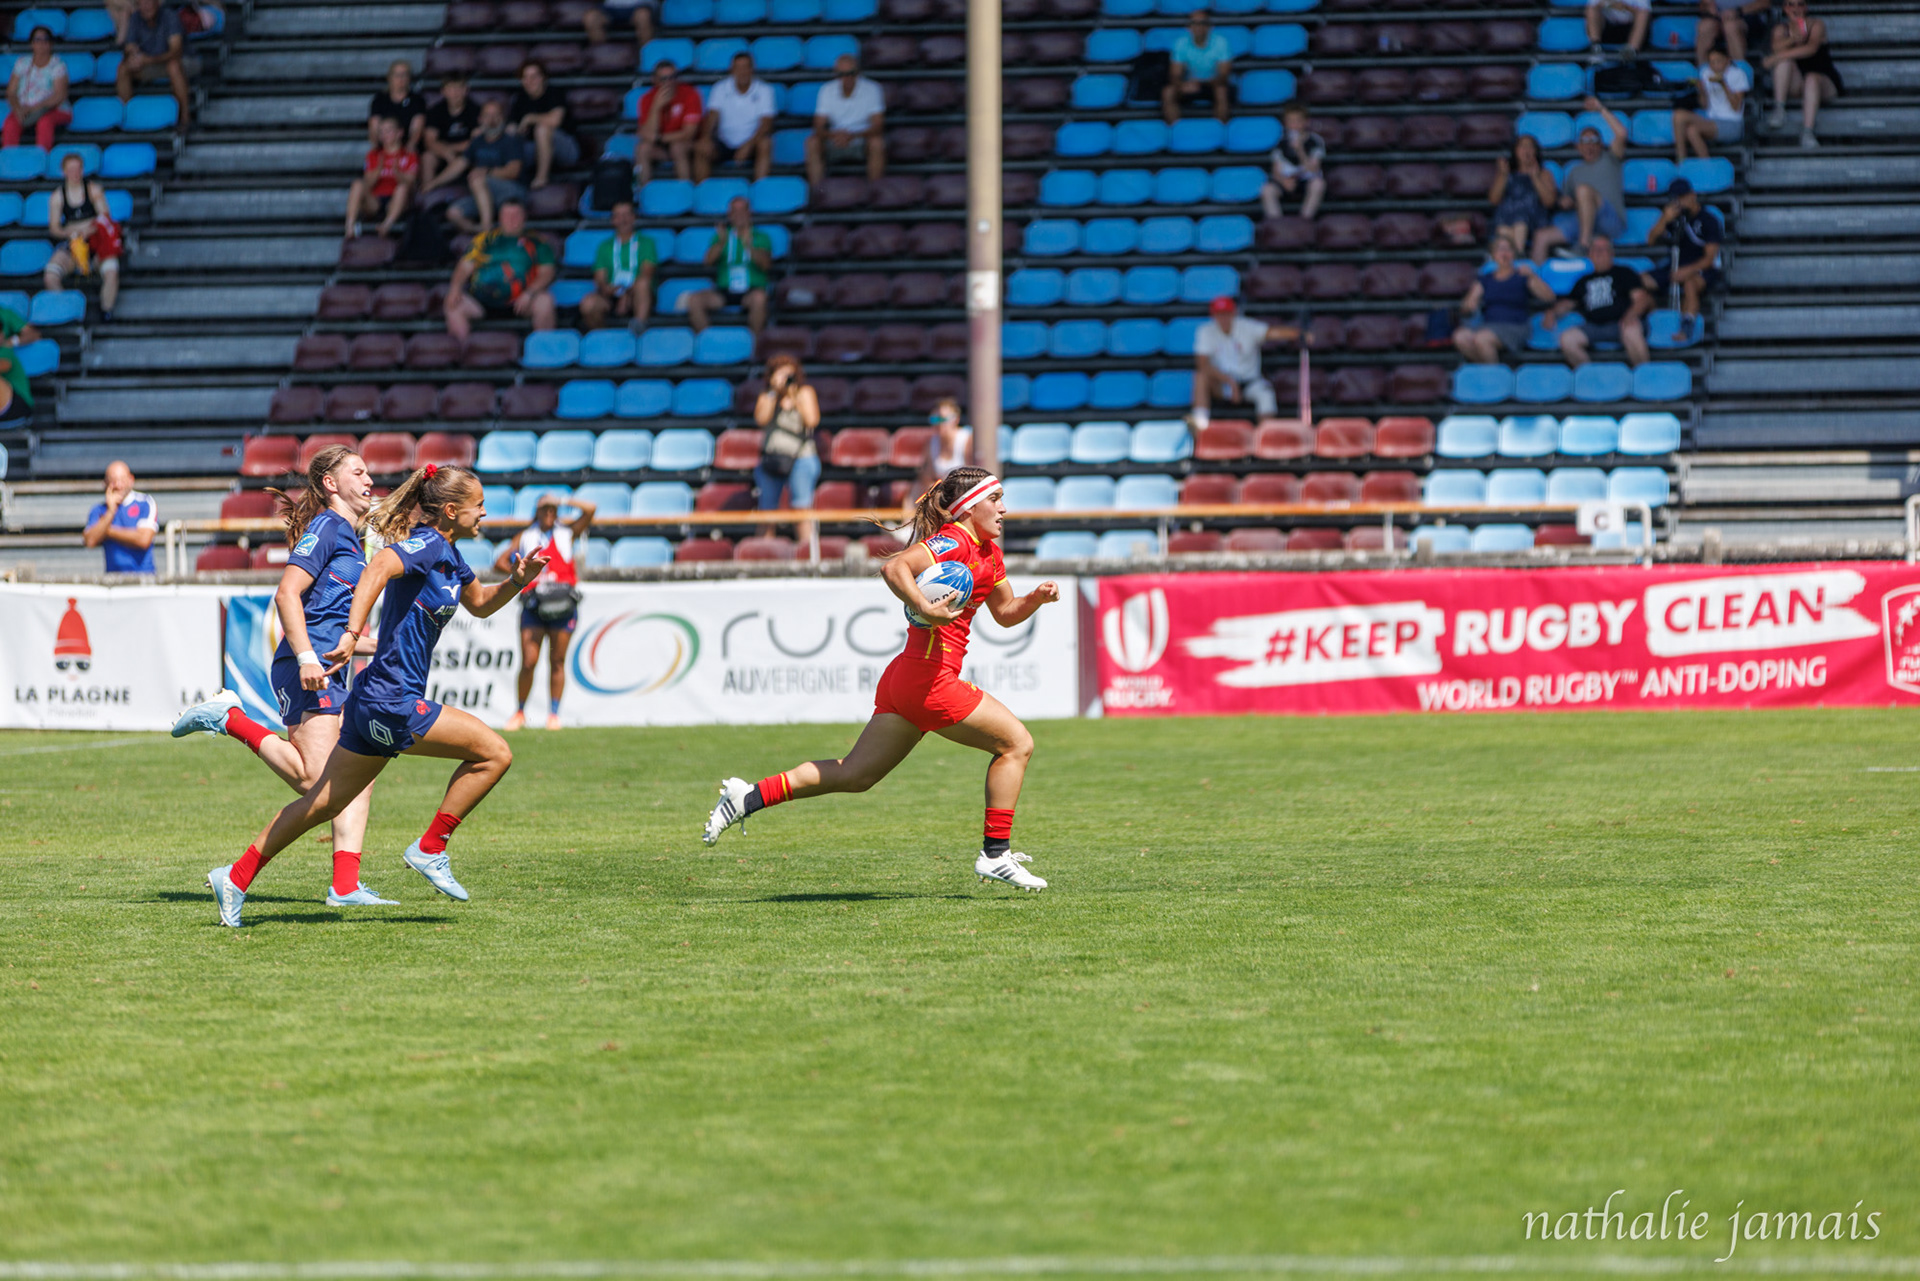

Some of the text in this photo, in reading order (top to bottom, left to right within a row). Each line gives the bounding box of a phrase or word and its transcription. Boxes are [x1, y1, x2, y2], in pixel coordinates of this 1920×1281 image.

[1264, 587, 1825, 666] #KEEP RUGBY CLEAN
[15, 686, 131, 705] LA PLAGNE
[722, 666, 851, 695] AUVERGNE
[1417, 676, 1522, 712] WORLD
[1640, 656, 1828, 699] ANTI-DOPING
